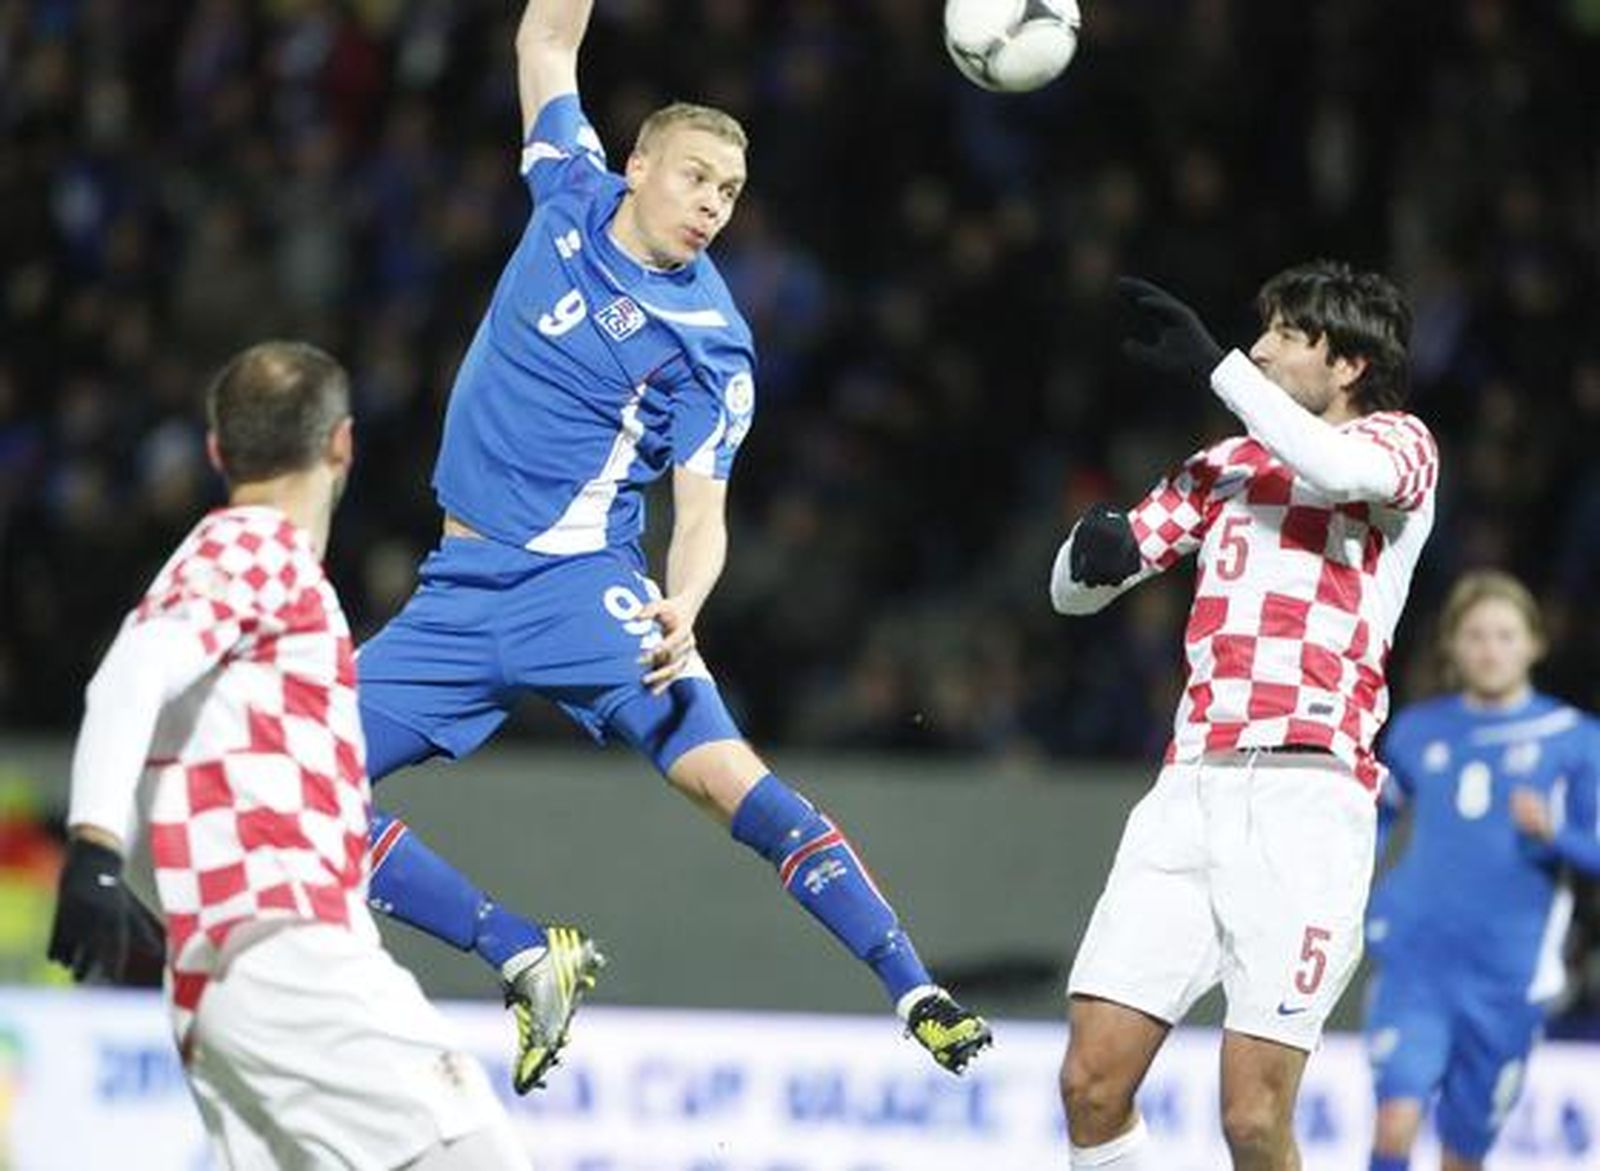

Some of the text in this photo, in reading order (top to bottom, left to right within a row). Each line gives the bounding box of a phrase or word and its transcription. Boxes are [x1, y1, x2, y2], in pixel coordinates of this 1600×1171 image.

[537, 288, 587, 337] 9
[1215, 513, 1252, 582] 5
[1294, 925, 1331, 995] 5
